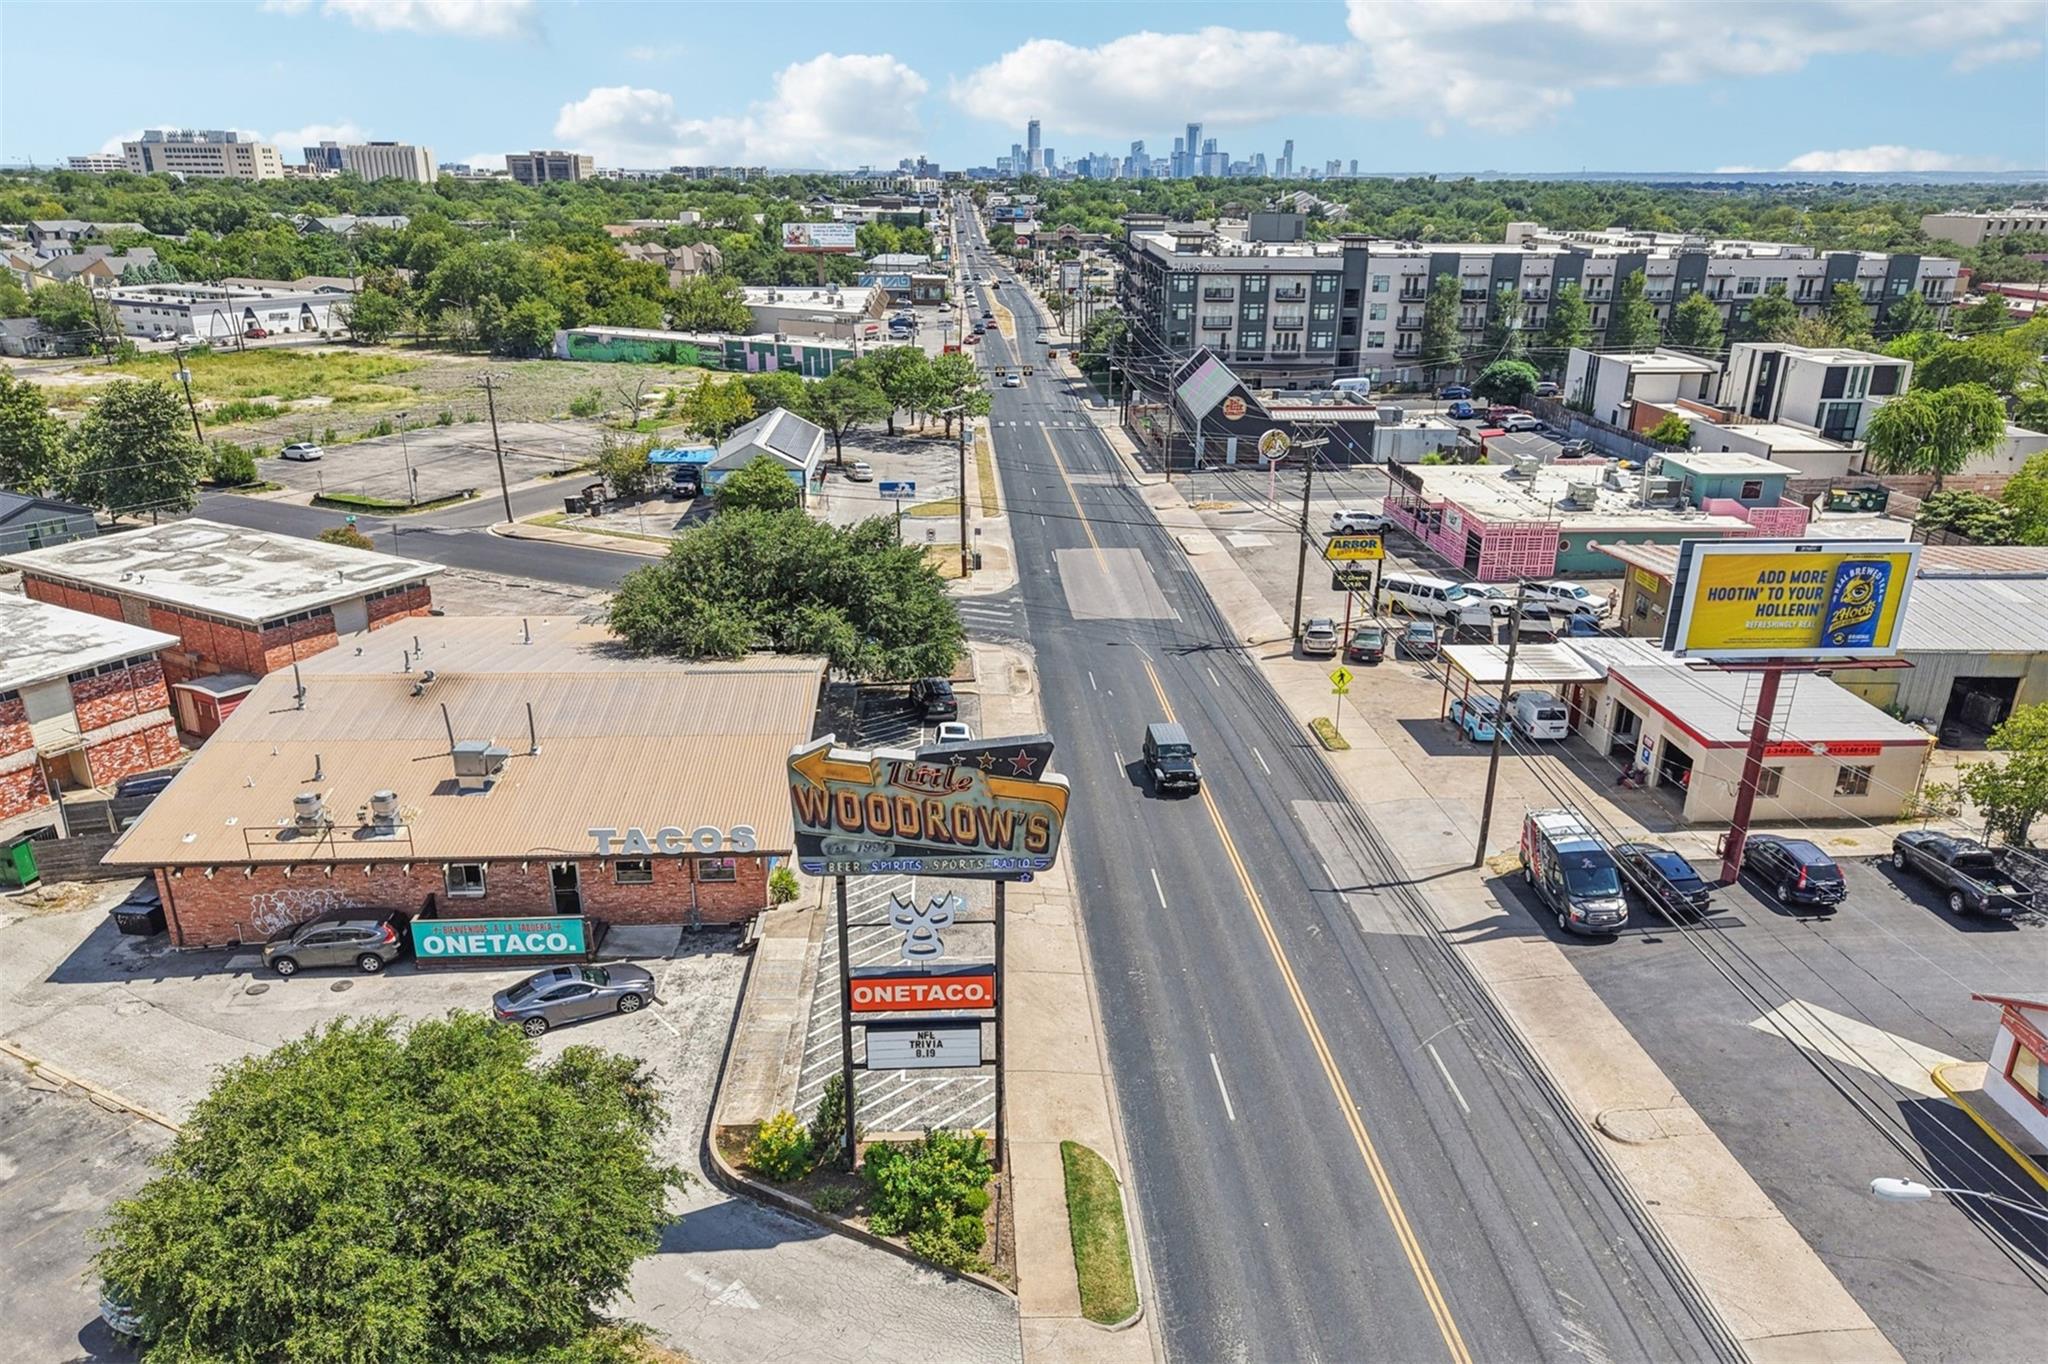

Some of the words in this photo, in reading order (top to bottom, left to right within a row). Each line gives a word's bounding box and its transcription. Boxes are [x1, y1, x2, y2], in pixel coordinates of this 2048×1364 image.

[1333, 539, 1377, 549] ARBOR
[1757, 570, 1787, 584] ADD
[1789, 570, 1829, 584] MORE
[1849, 566, 1882, 580] BREWED
[1707, 586, 1764, 601] HOOTIN'
[1768, 586, 1785, 600] TO
[1788, 586, 1825, 600] YOUR
[1755, 602, 1825, 617] HOLLERIN'
[1745, 620, 1797, 629] REFRESHINGLY
[1798, 620, 1816, 629] REAL
[886, 761, 974, 797] Little
[792, 783, 1050, 854] WOODROW'S
[588, 825, 757, 856] TACOS
[827, 860, 861, 872] BEER
[870, 859, 922, 872] SPIRITS
[932, 859, 984, 870] SPORTS
[423, 932, 577, 955] ONETACO.
[853, 983, 991, 1004] ONETACO.
[917, 1031, 936, 1041] NFL
[909, 1040, 944, 1049] TRIVIA
